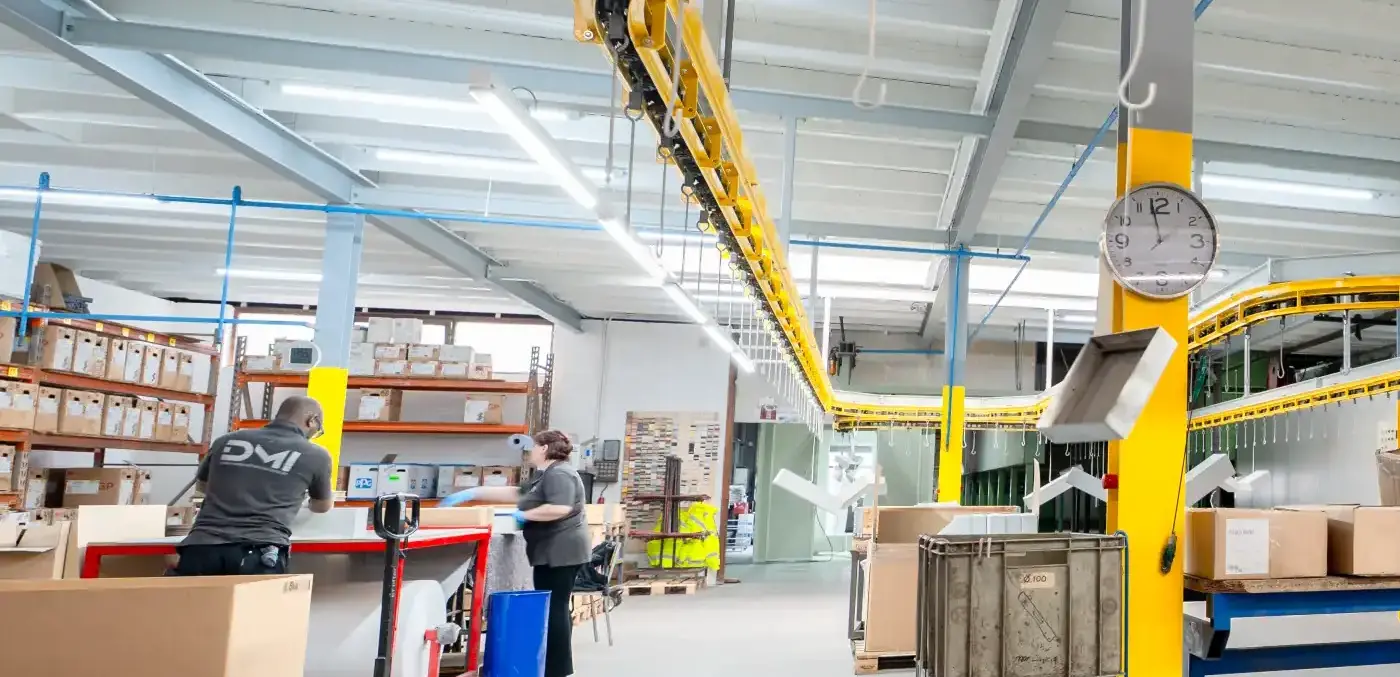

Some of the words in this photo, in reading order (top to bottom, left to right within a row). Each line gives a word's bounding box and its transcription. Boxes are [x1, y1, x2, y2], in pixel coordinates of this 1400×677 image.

[1136, 202, 1143, 213] 11
[1149, 197, 1170, 214] 12
[1119, 215, 1132, 227] 10
[1188, 216, 1197, 226] 2
[1115, 233, 1130, 249] 9
[1190, 233, 1206, 249] 3
[1124, 257, 1132, 267] 8
[220, 439, 302, 472] DMI
